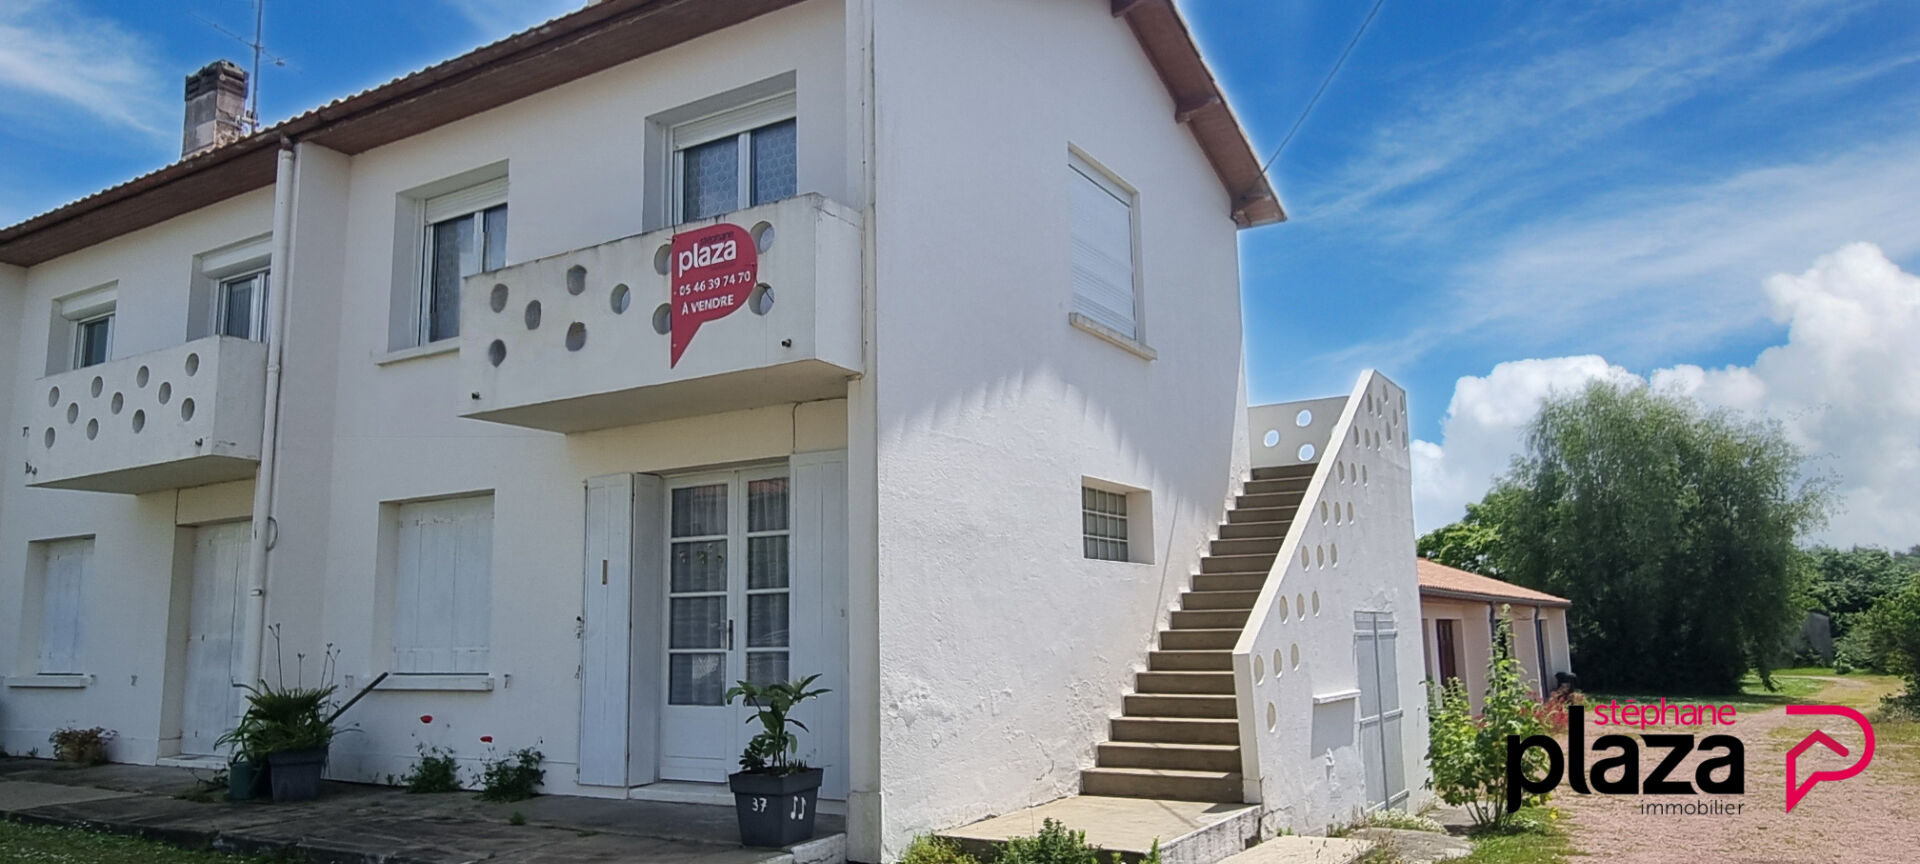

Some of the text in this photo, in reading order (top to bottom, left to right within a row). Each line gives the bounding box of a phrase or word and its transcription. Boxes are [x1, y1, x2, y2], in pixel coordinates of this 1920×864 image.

[679, 240, 736, 278] plaza
[680, 270, 751, 296] 05 46 39 74 70
[691, 294, 734, 313] VENDRE
[752, 798, 767, 812] 37
